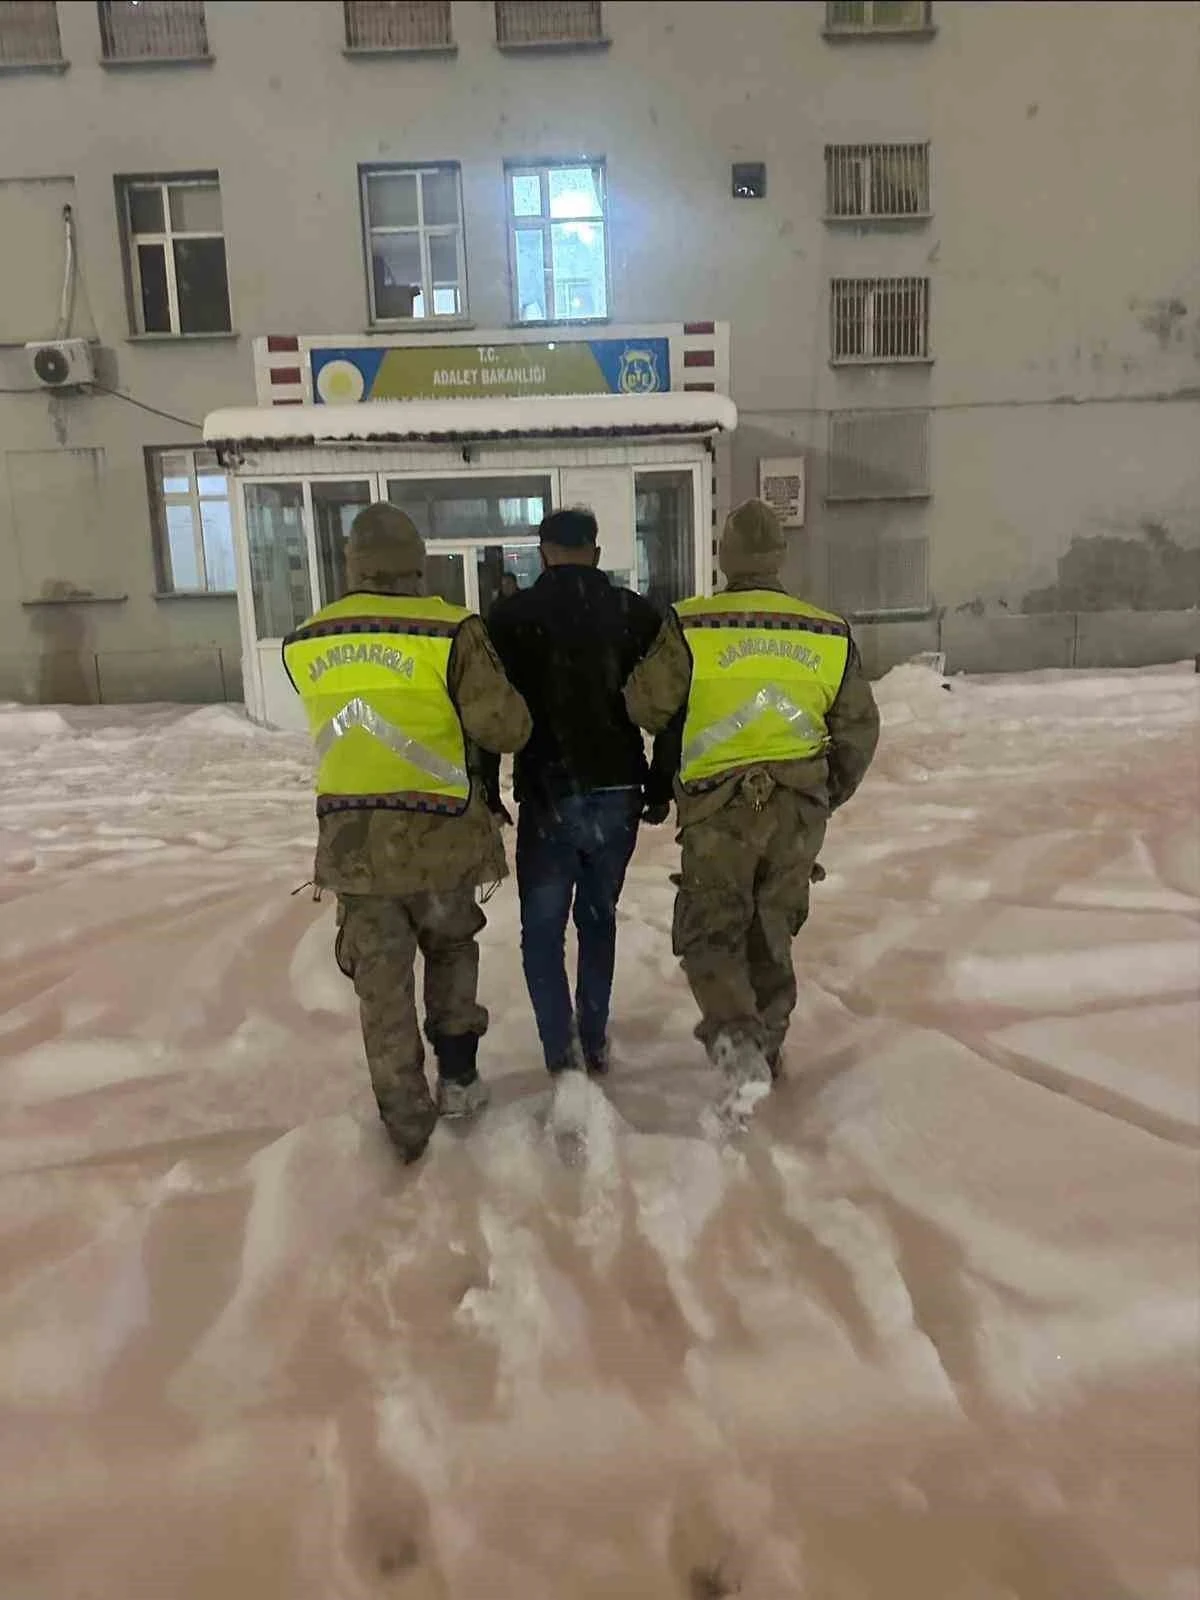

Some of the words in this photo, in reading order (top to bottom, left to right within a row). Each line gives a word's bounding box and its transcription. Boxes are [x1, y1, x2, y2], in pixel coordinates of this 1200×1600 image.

[433, 368, 478, 385] ADALET
[481, 364, 546, 385] BAKANLIĞI
[308, 643, 414, 682] JANDARMA
[719, 638, 821, 673] JANDARMA
